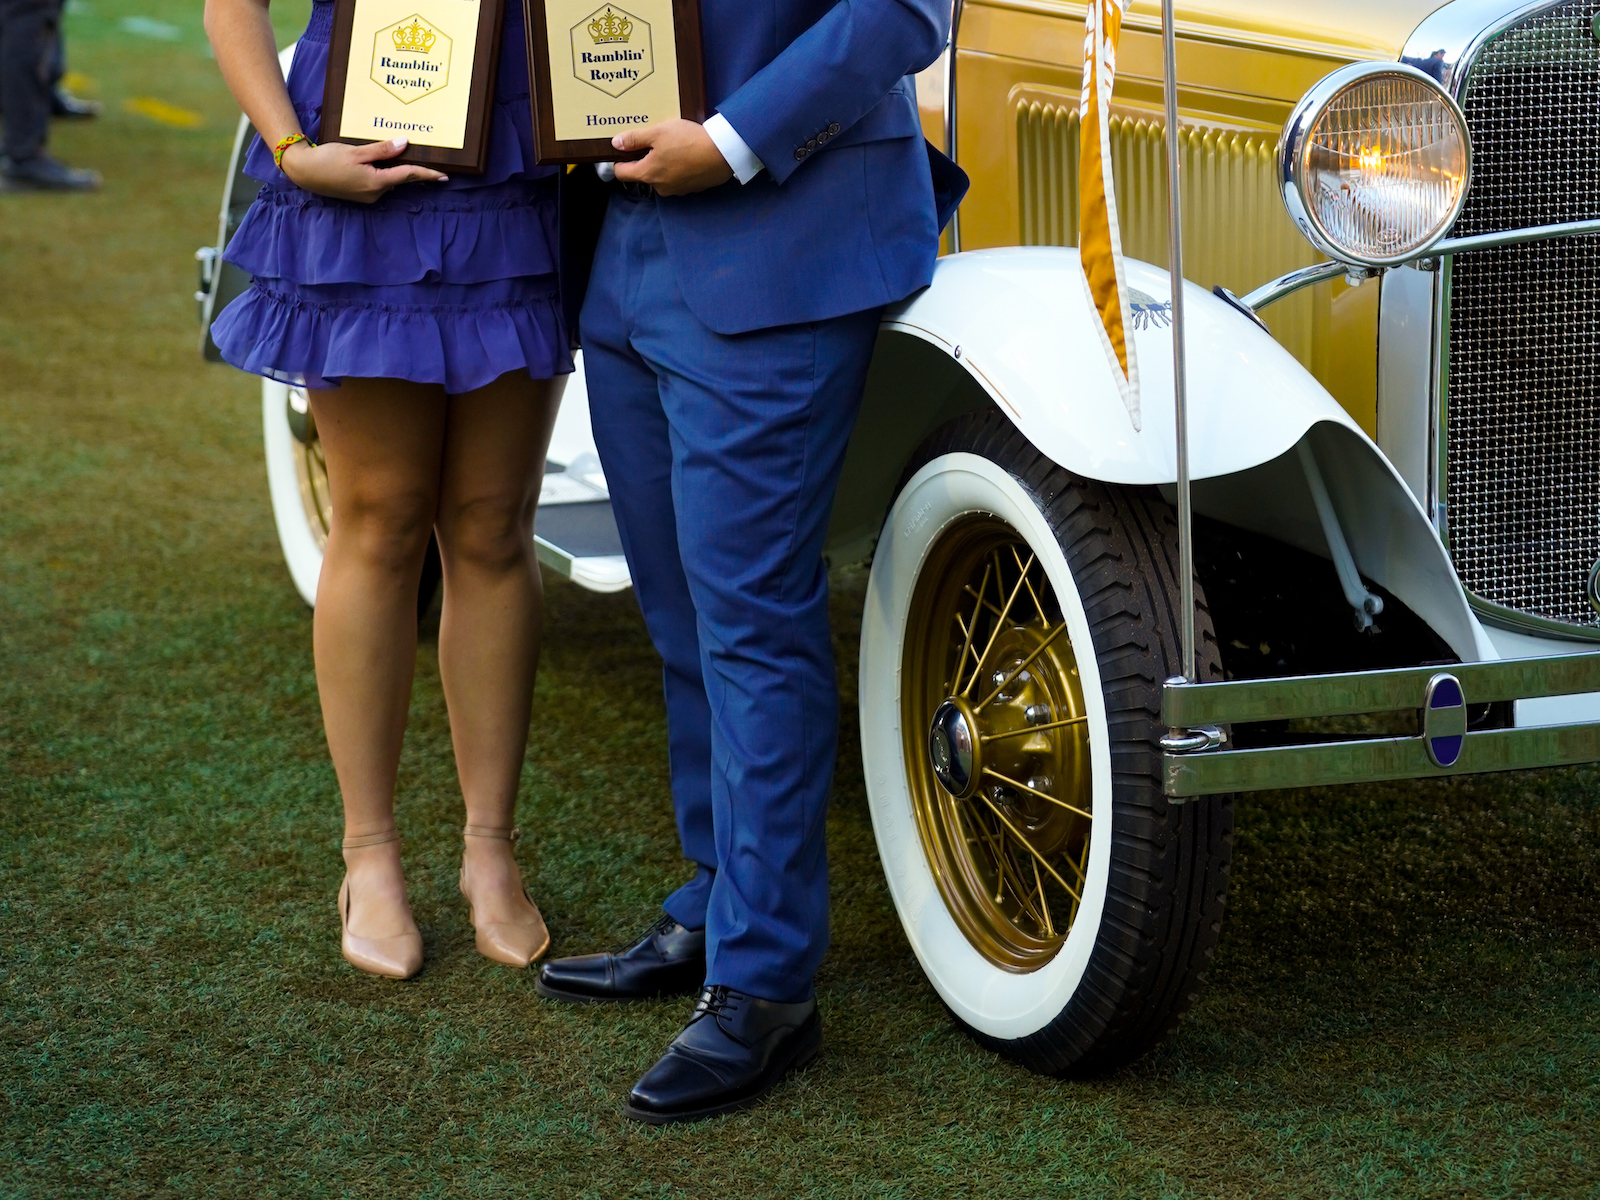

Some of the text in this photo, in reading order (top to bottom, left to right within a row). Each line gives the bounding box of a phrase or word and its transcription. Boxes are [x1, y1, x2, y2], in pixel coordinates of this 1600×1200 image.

[581, 49, 645, 63] Ramblin'
[380, 57, 443, 72] Ramblin'
[590, 68, 640, 82] Royalty
[385, 74, 434, 91] Royalty
[373, 117, 434, 133] Honoree
[586, 114, 649, 126] Honoree
